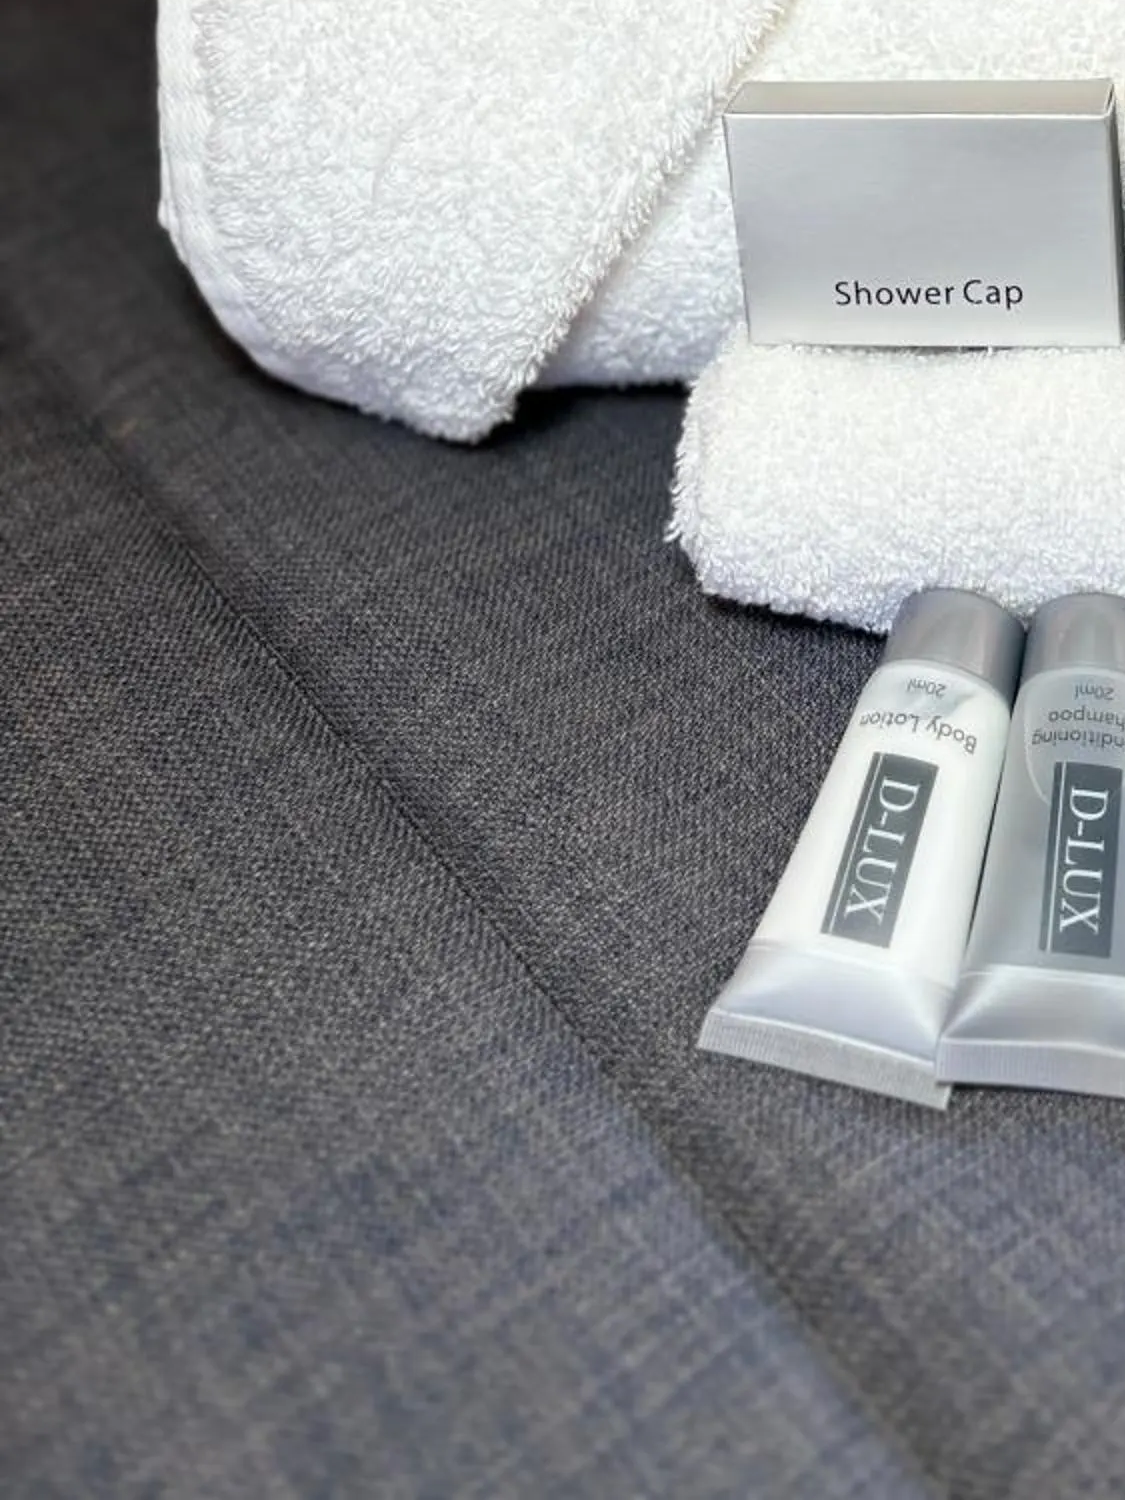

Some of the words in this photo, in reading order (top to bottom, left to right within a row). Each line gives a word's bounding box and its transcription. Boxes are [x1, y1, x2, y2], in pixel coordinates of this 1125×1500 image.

[835, 280, 955, 305] Shower
[962, 279, 1024, 310] Cap
[906, 678, 947, 697] 20ml
[1074, 683, 1115, 701] 20ml
[860, 711, 920, 732] Lotion
[925, 715, 978, 754] Body
[845, 778, 920, 925] D-LUX
[1058, 787, 1109, 935] D-LUX
